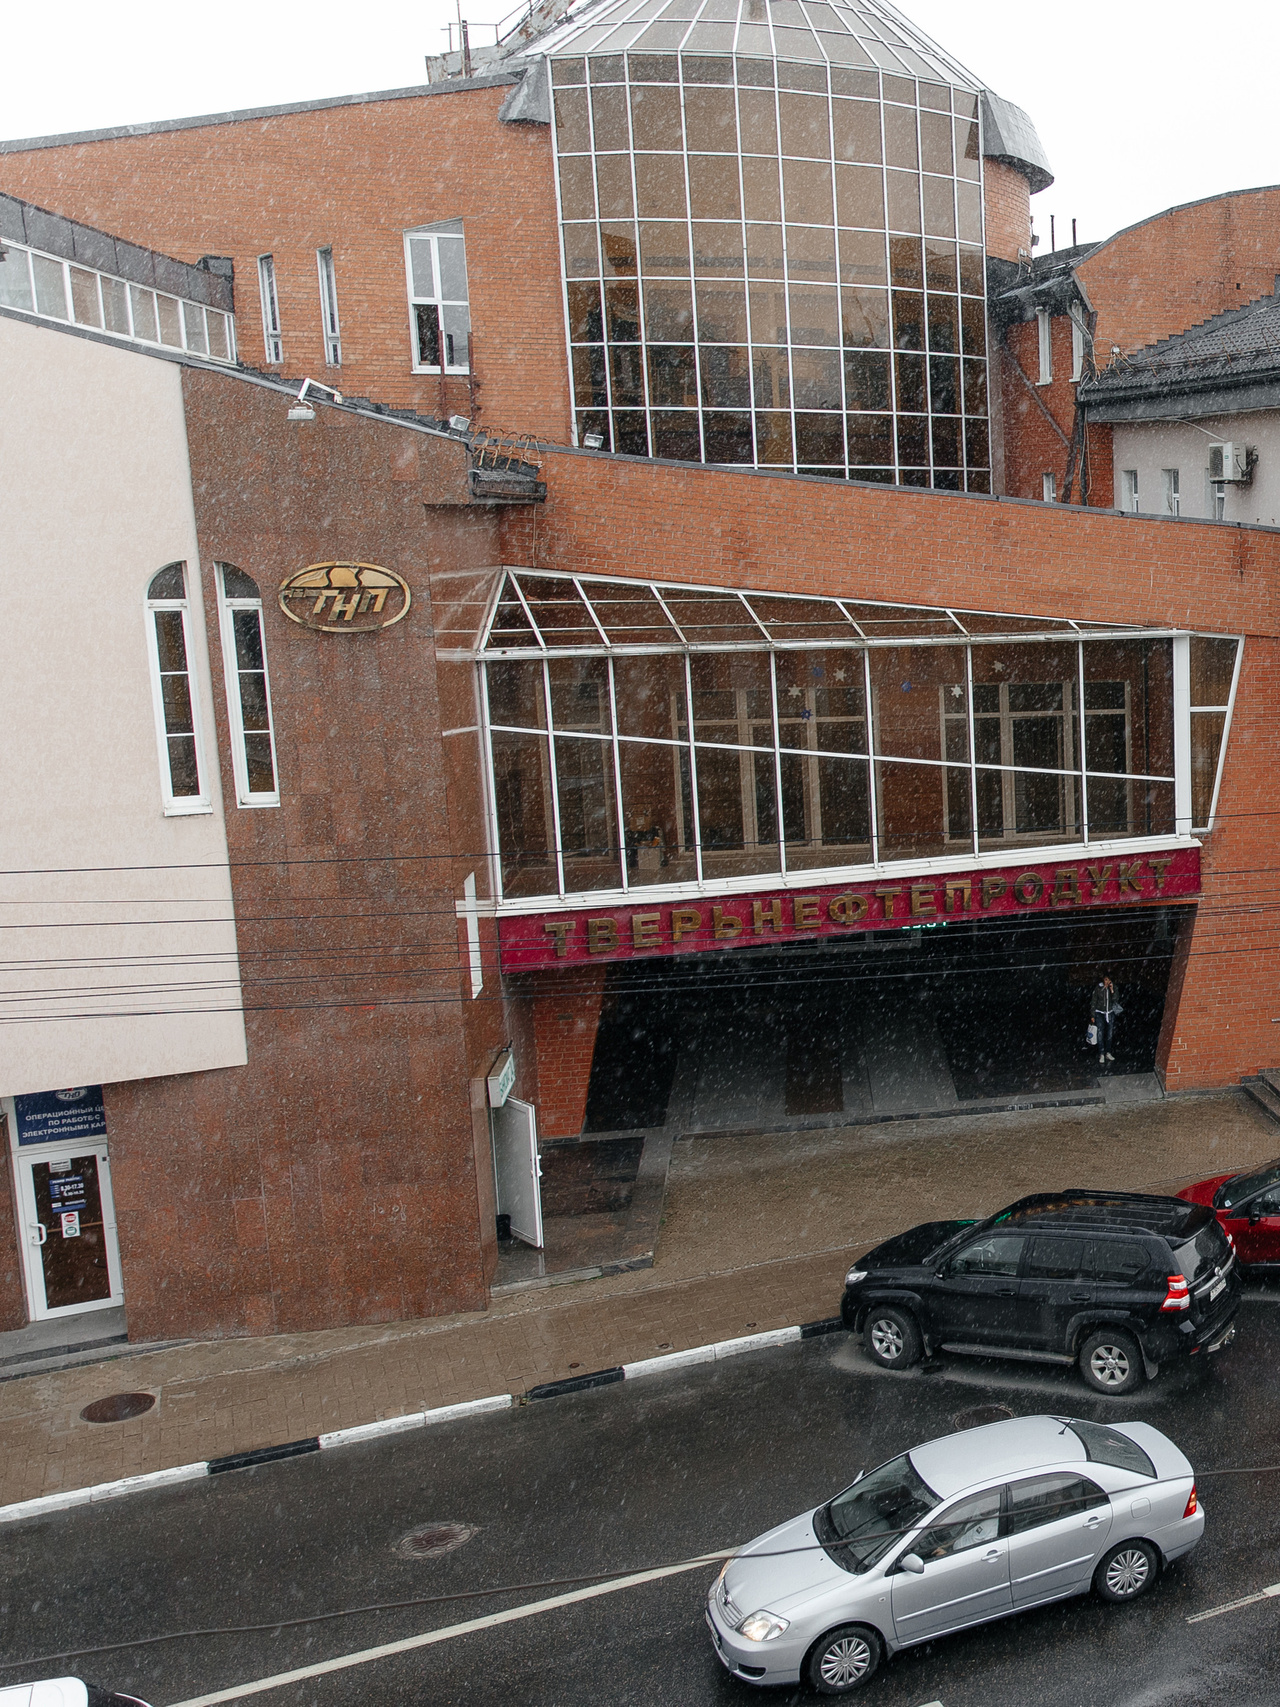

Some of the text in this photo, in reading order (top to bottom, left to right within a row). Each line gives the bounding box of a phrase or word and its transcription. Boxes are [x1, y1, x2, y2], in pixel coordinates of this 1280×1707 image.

[544, 858, 1172, 957] ТВЕРЬНЕФТЕПРОДУКТ
[25, 1107, 93, 1121] ОПЕРАЦИОННЫЙ
[61, 1115, 94, 1125] РАБОТЕ
[22, 1123, 89, 1137] ЭЛЕКТРОННЫМИ
